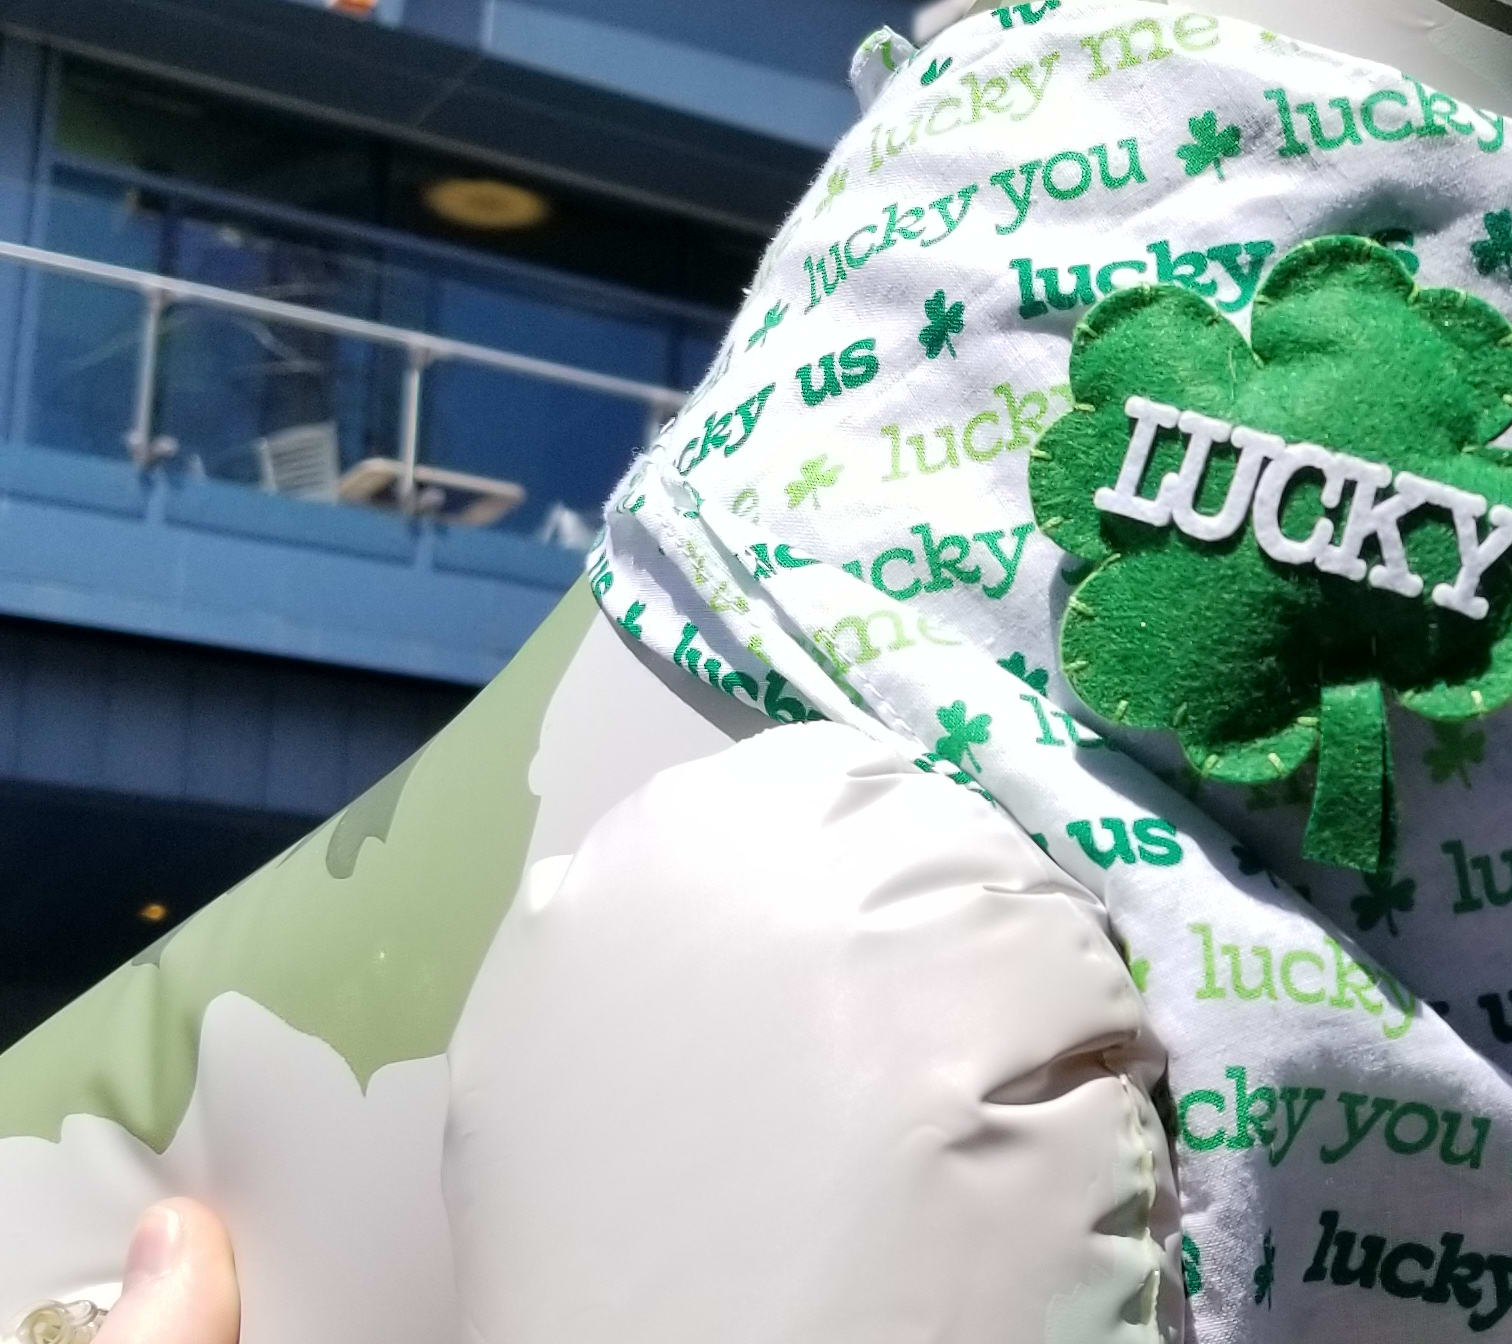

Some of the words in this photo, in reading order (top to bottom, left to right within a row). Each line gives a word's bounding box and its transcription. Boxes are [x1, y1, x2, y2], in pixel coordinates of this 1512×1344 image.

[868, 51, 1060, 174] lucky
[1080, 12, 1219, 81] me
[803, 184, 978, 315] lucky
[990, 137, 1148, 235] you
[796, 336, 879, 407] us
[1066, 816, 1183, 871] us
[1188, 922, 1420, 1039] lucky
[1177, 1066, 1326, 1168] cky
[1320, 1089, 1492, 1170] you
